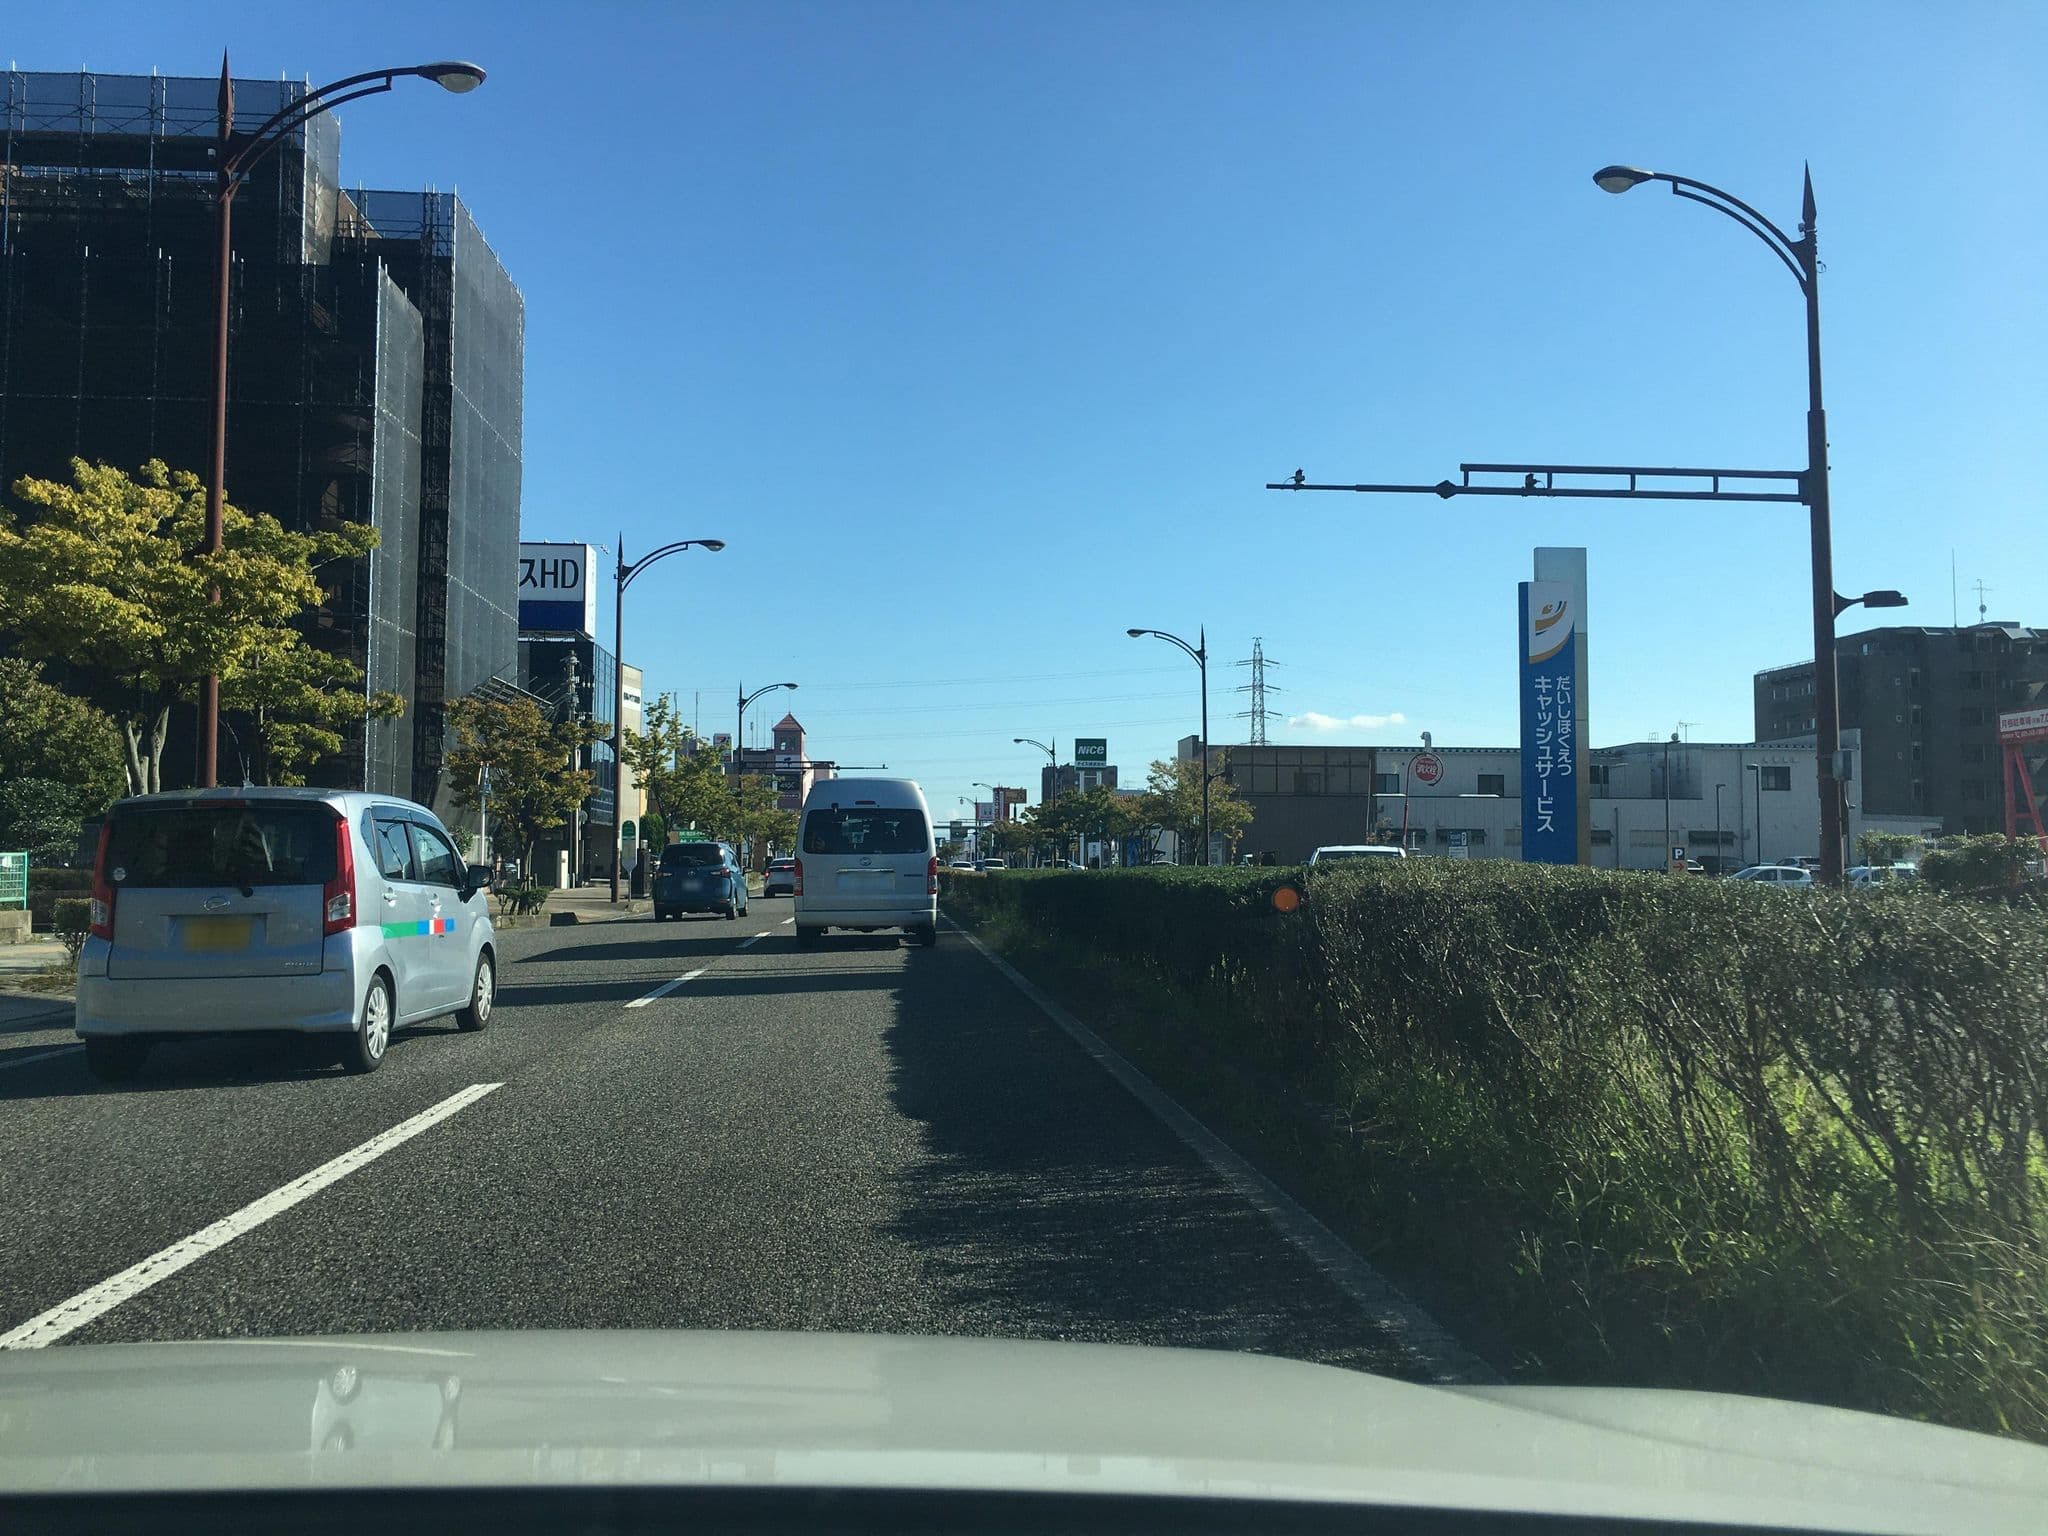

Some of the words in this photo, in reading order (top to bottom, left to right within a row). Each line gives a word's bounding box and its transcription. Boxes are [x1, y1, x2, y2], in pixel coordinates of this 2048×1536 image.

[519, 559, 579, 589] スHD
[1533, 675, 1555, 834] キャッシュサービス
[1556, 675, 1573, 777] だいしほくえつ
[1674, 848, 1684, 859] P
